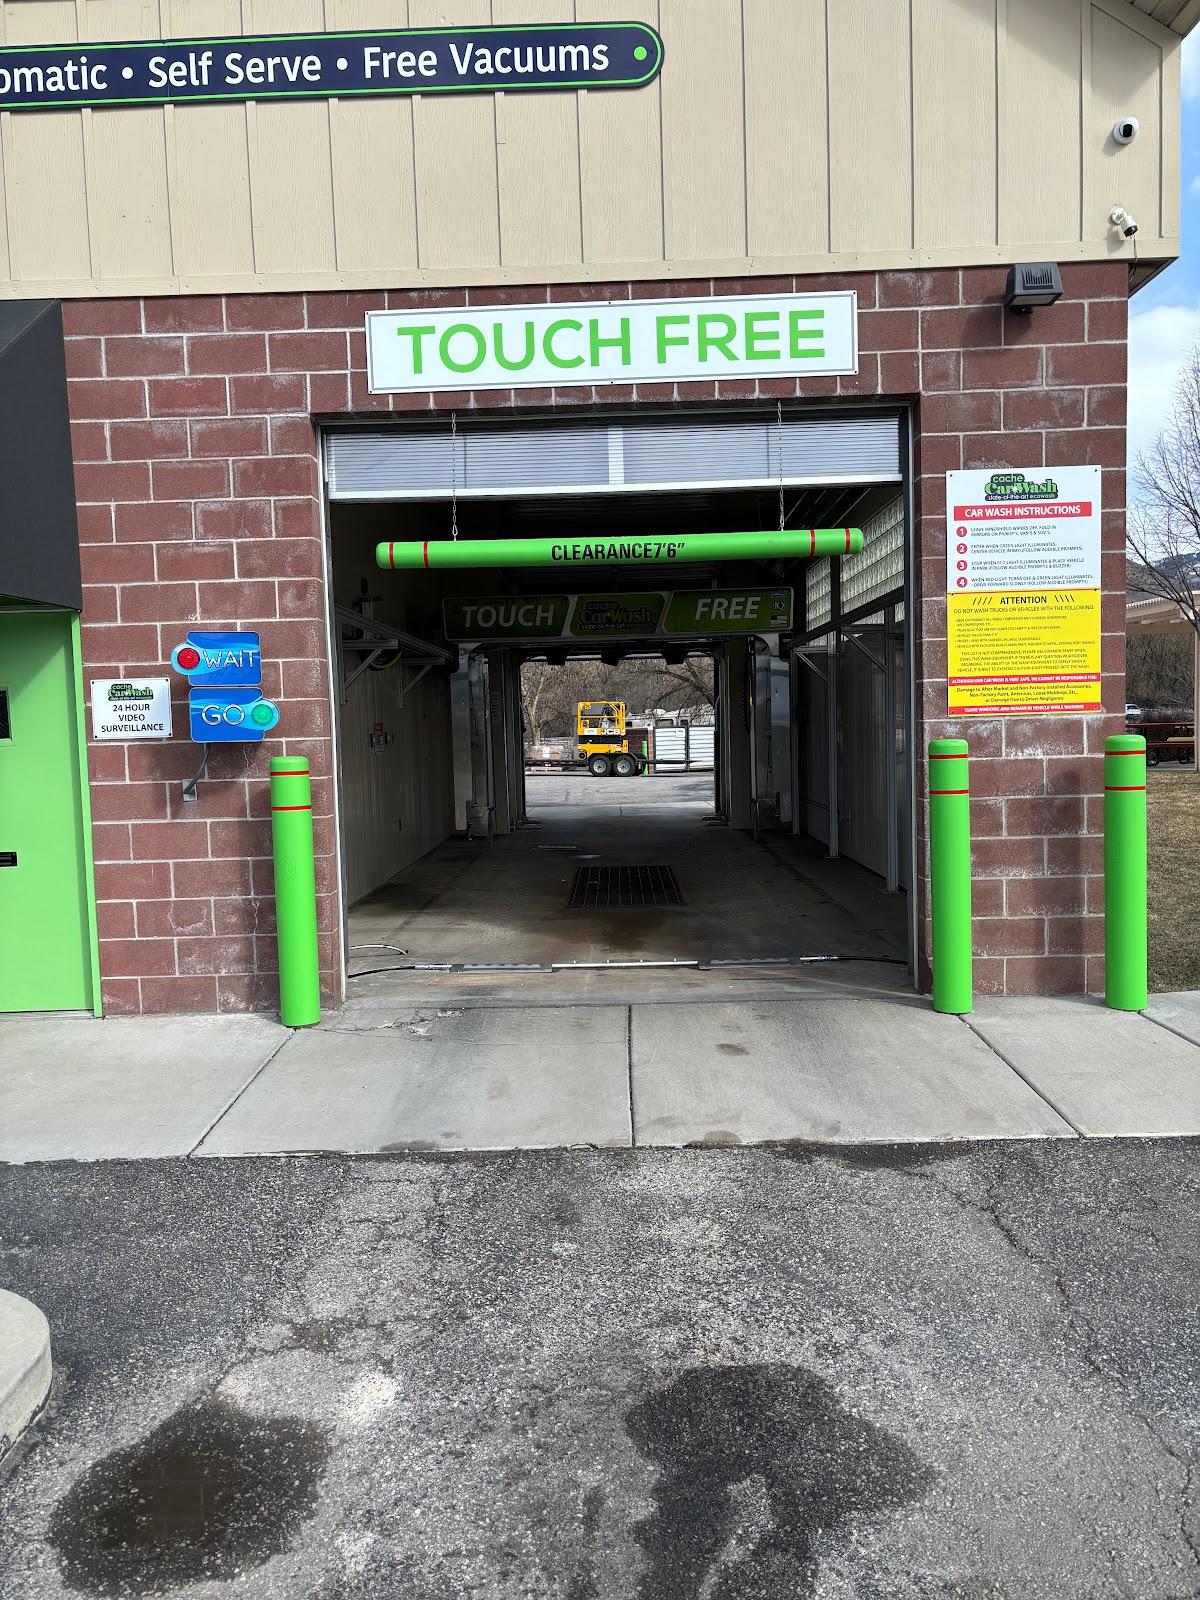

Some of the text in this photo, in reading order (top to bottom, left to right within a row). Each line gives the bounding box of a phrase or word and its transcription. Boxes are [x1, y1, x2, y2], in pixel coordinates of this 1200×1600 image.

[149, 51, 213, 88] Self
[224, 52, 322, 84] Serve
[364, 46, 438, 79] Free
[449, 42, 609, 75] Vacuums
[397, 309, 826, 374] TOUCH FREE
[993, 474, 1024, 482] cache
[964, 505, 1080, 518] CAR WASH INSTRUCTIONS
[1000, 596, 1047, 604] ATTENTION
[462, 596, 761, 628] TOUCH FREE
[202, 650, 259, 668] WAIT
[202, 704, 245, 726] GO
[101, 724, 164, 732] SURVEILLANCE
